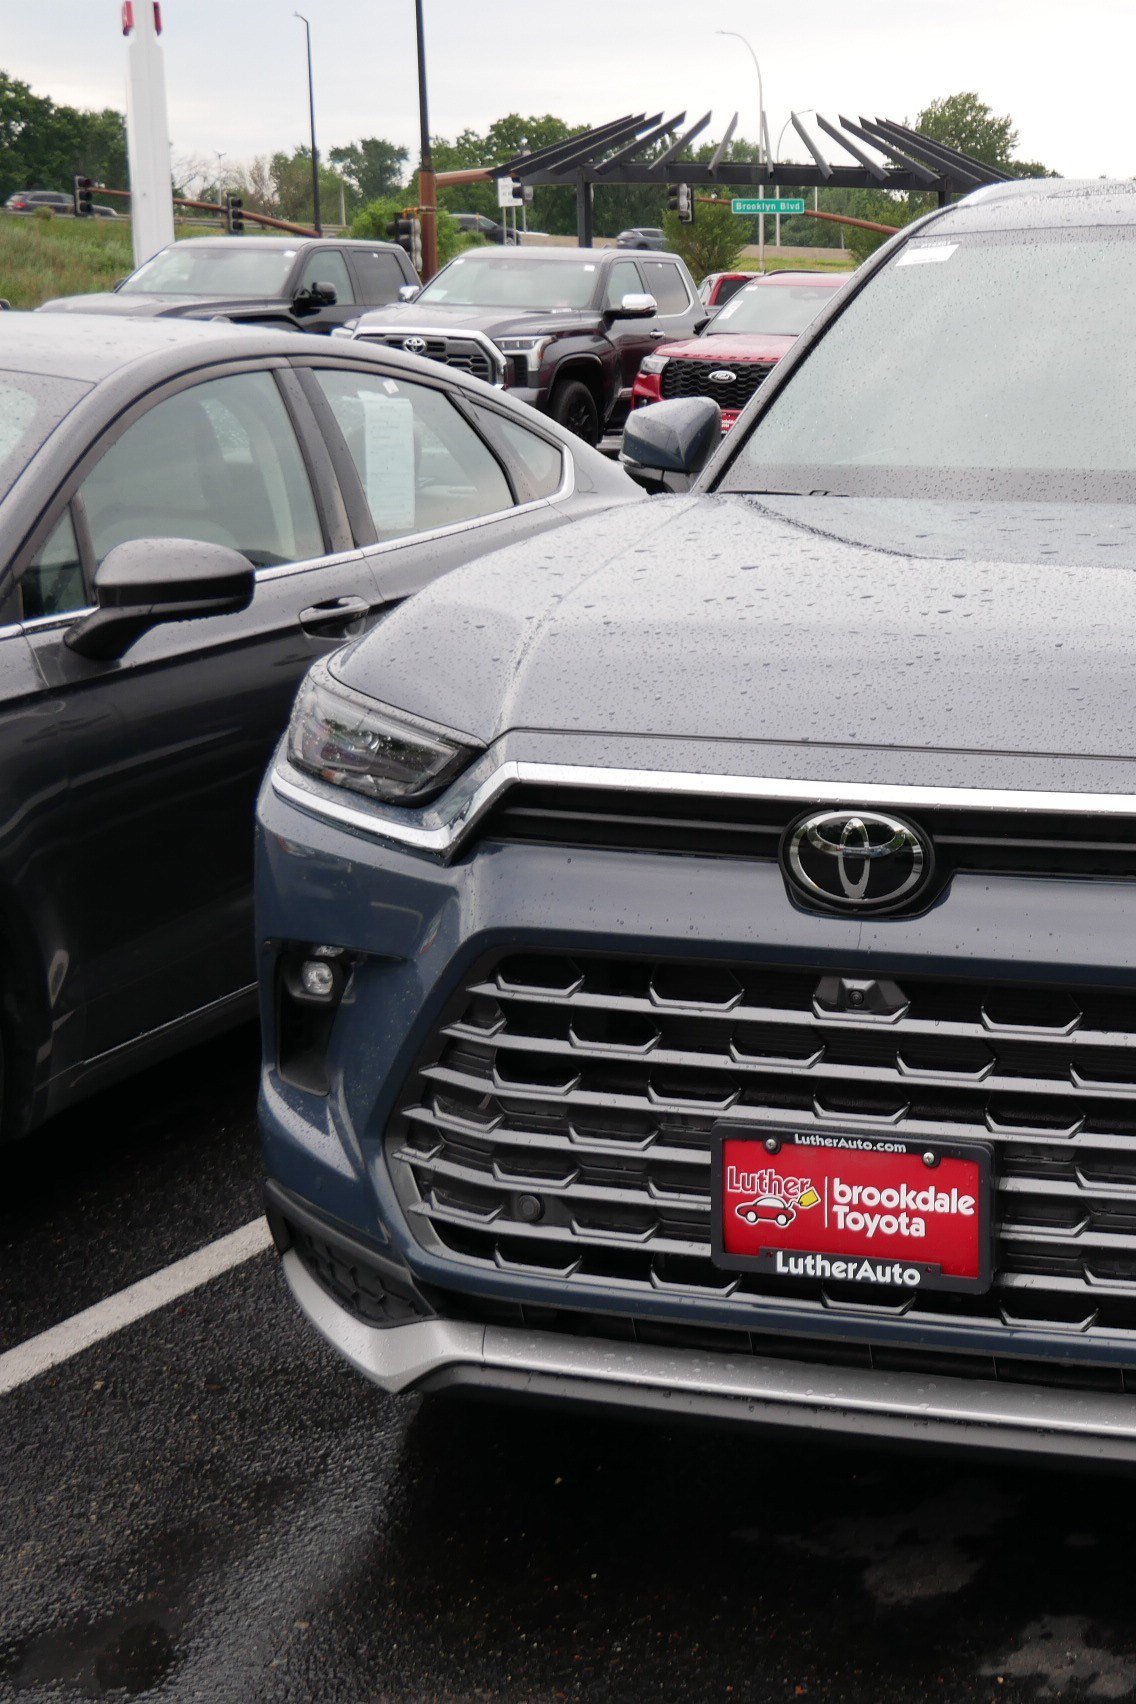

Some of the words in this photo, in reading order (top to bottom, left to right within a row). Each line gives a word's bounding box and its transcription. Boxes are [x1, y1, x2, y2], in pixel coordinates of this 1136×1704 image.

[736, 202, 776, 212] Brooklyn
[780, 202, 800, 210] Blvd
[794, 1133, 906, 1153] LutherAuto.com
[727, 1166, 811, 1198] Luther
[833, 1177, 976, 1216] brookdale
[832, 1204, 926, 1238] Toyota
[775, 1250, 921, 1286] LutherAuto
